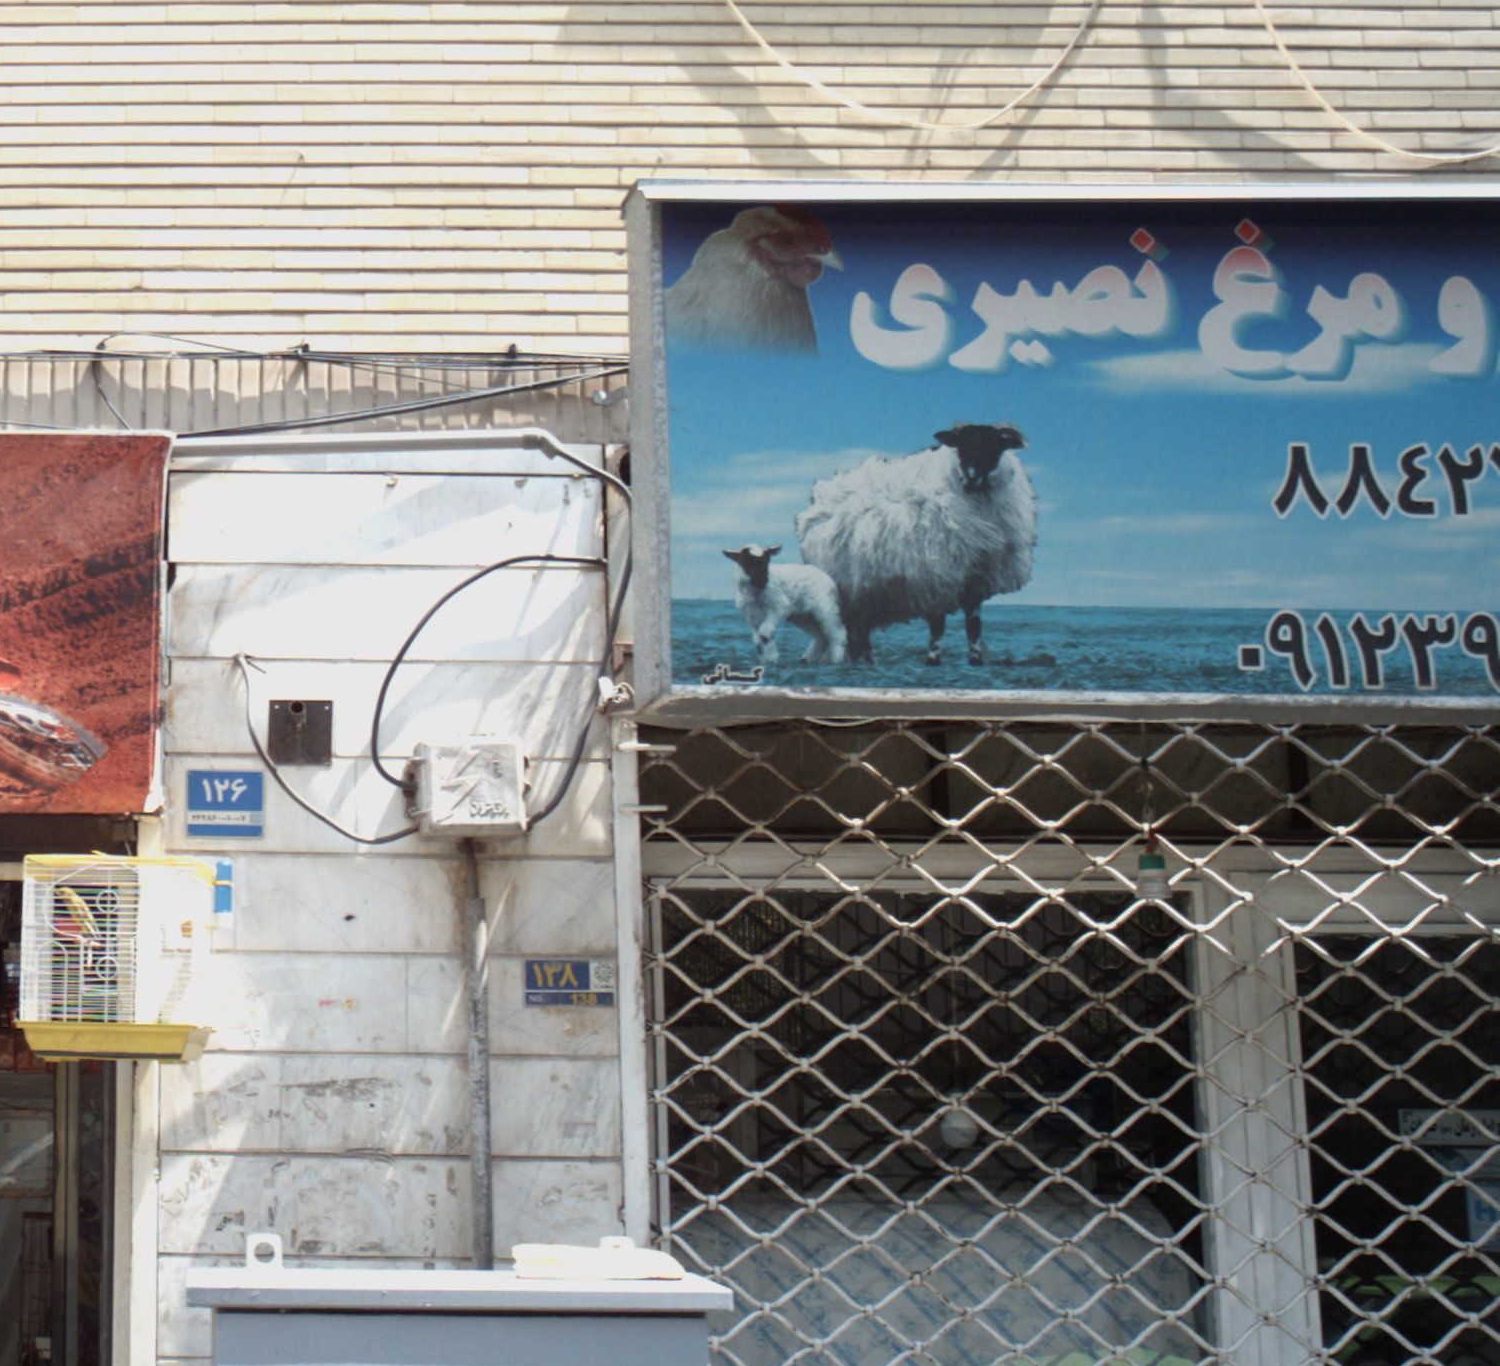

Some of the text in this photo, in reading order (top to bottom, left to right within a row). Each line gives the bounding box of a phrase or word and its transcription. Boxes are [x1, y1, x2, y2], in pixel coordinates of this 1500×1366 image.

[851, 219, 1488, 377] و مرغ نصیری
[202, 778, 248, 803] ۱۲۶
[532, 963, 578, 987] ۱۳۸
